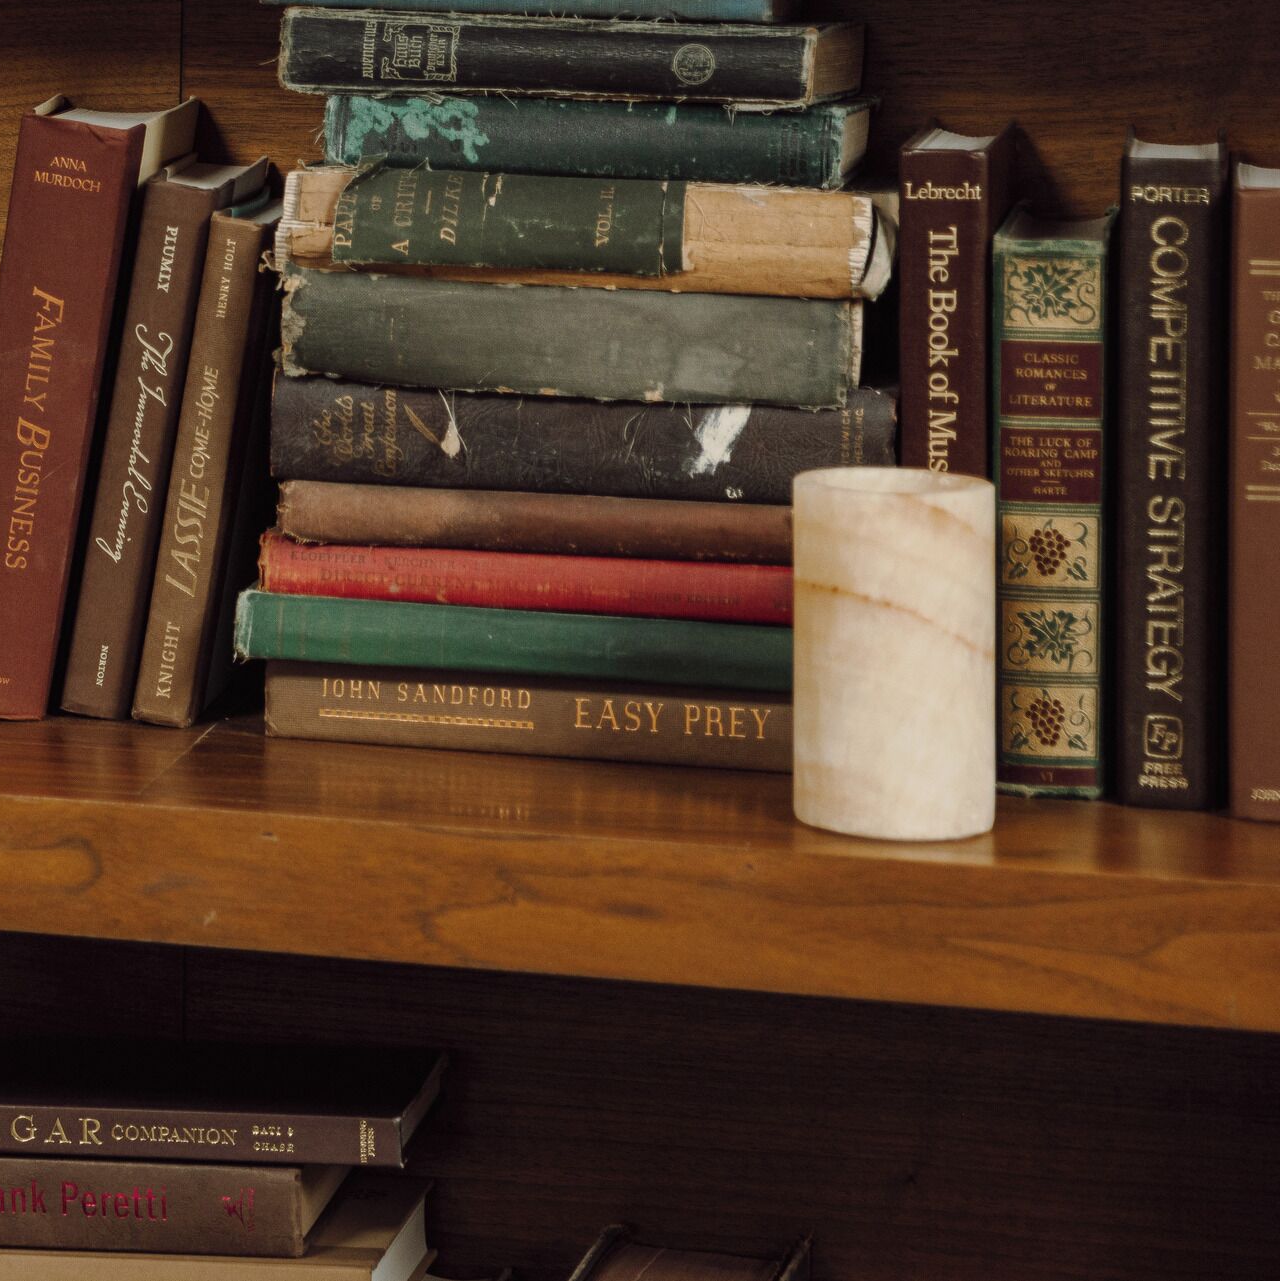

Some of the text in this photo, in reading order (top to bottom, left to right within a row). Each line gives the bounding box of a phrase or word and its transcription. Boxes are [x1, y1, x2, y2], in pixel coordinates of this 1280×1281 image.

[50, 155, 88, 173] ANNA
[33, 170, 102, 193] MURDOCH
[904, 180, 983, 202] Lebrecht
[371, 194, 382, 211] OF
[1130, 184, 1210, 205] PORTER
[440, 174, 465, 247] DILKE
[594, 204, 613, 248] VOL.
[392, 238, 410, 256] A
[156, 225, 179, 293] PLUMLY
[215, 238, 237, 319] HENRY HOLT
[927, 226, 960, 405] The Book of
[1023, 352, 1080, 366] CLASSIC
[1015, 368, 1088, 381] ROMANCES
[1045, 383, 1057, 391] OF
[1009, 395, 1094, 408] LITERATURE
[4, 285, 66, 570] FAMILY BUSINESS
[353, 401, 375, 459] Great
[95, 323, 174, 565] The Immortal Evening
[1004, 447, 1099, 459] ROARING CAMP
[1009, 436, 1094, 448] THE LUCK OF
[1040, 459, 1062, 469] AND
[1145, 214, 1190, 703] COMPETITIVE STRATEGY
[165, 365, 220, 598] LASSIE COME-HOME
[1006, 468, 1096, 479] OTHER SKETCHES
[1033, 485, 1069, 496] HARTE
[95, 644, 110, 688] NORTON
[155, 620, 183, 700] KNIGHT
[321, 678, 772, 741] JOHN SANDFORD EASY PREY
[1143, 762, 1184, 776] FREE
[1138, 775, 1190, 790] PRESS
[111, 1123, 238, 1146] COMPANION
[252, 1141, 295, 1154] CHASE
[61, 1180, 171, 1223] Peretti
